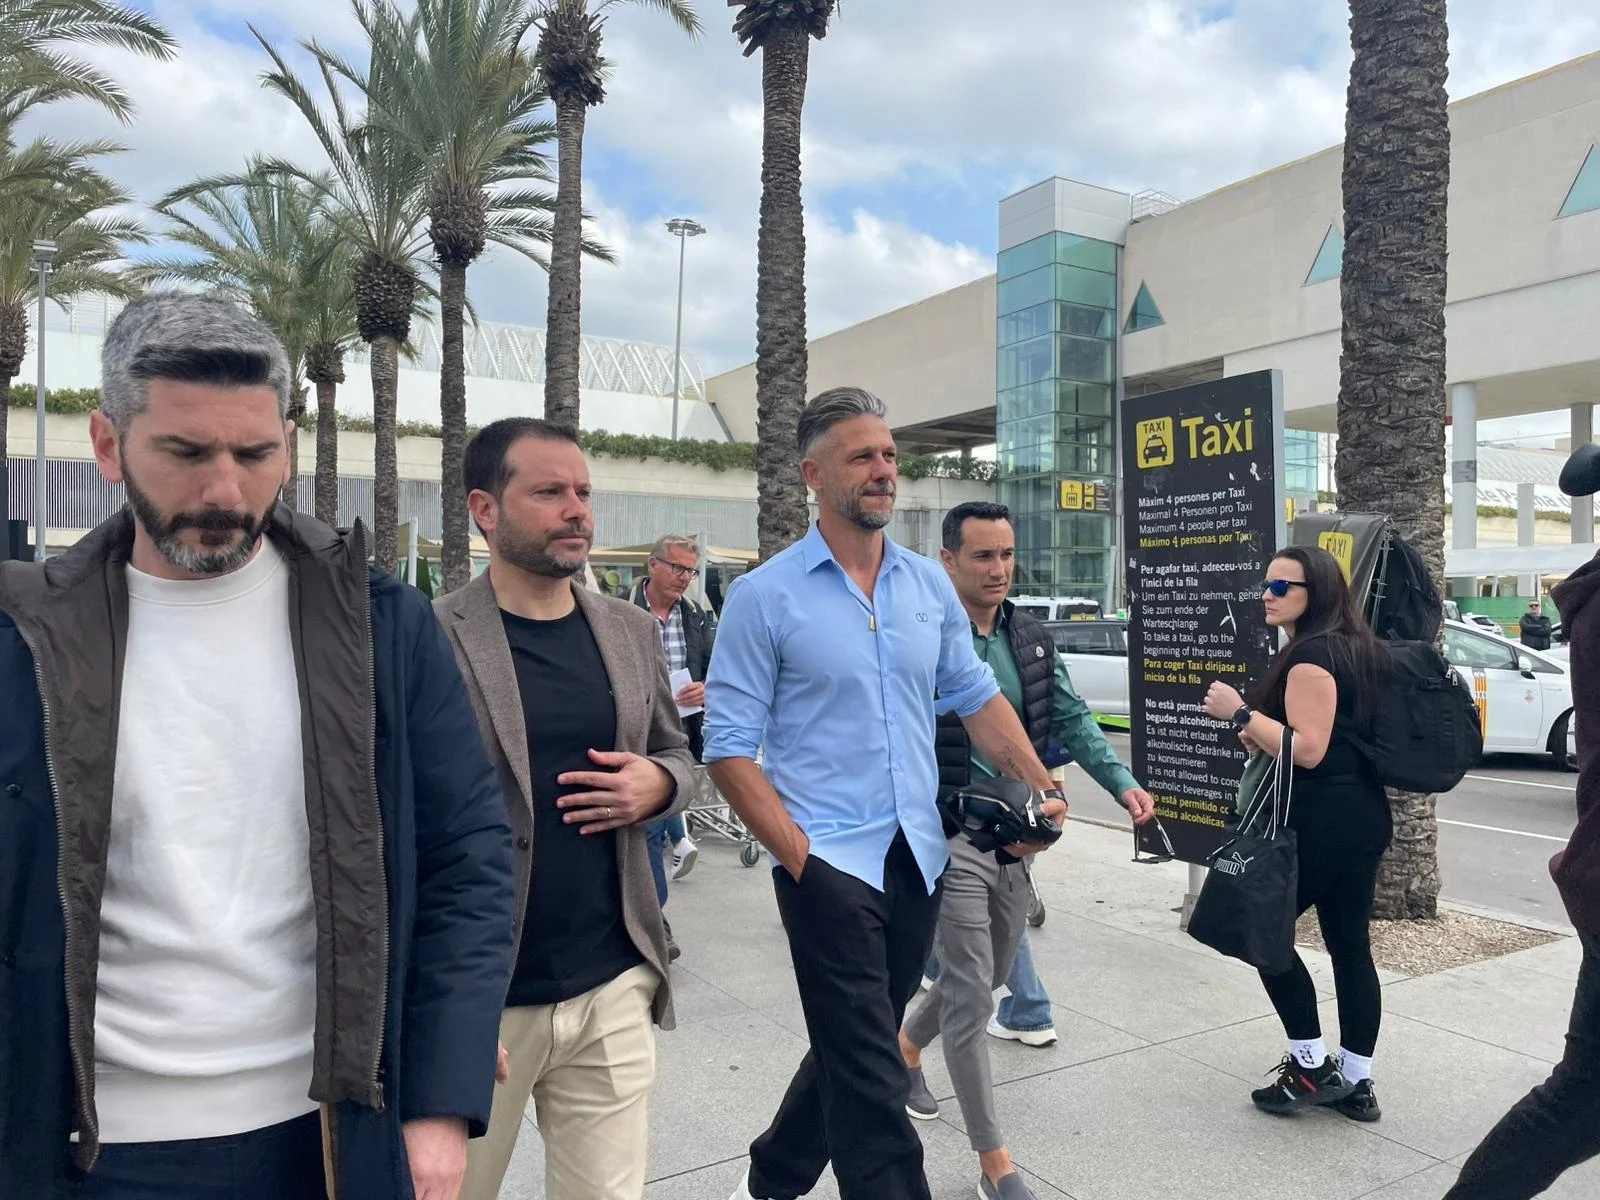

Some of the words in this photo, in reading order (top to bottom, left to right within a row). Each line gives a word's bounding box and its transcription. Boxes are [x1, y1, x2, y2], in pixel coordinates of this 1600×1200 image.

[1143, 421, 1165, 434] TAXI
[1181, 407, 1253, 459] Taxi
[1138, 496, 1164, 507] Màxim
[1166, 495, 1172, 504] 4
[1174, 492, 1209, 506] persones
[1212, 491, 1226, 502] per
[1228, 487, 1245, 498] Taxi
[1139, 508, 1171, 521] Maximal
[1173, 508, 1179, 517] 4
[1181, 505, 1217, 517] Personen
[1220, 504, 1234, 516] pro
[1236, 500, 1252, 512] Taxi
[1139, 523, 1176, 534] Maximum
[1179, 521, 1185, 531] 4
[1187, 519, 1214, 532] people
[1216, 519, 1230, 531] per
[1232, 516, 1247, 527] taxi
[1140, 537, 1170, 548] Máximo
[1172, 536, 1178, 545] 4
[1180, 534, 1216, 547] personas
[1218, 533, 1233, 544] por
[1235, 531, 1252, 542] Taxi
[1325, 538, 1347, 558] TAXI
[1140, 564, 1153, 574] Per
[1155, 563, 1180, 575] agafar
[1182, 562, 1200, 573] taxi,
[1202, 560, 1252, 572] adreceu-vos
[1141, 578, 1162, 588] l'inici
[1164, 578, 1174, 587] de
[1176, 577, 1184, 587] la
[1186, 577, 1198, 587] fila
[1141, 592, 1155, 601] Um
[1157, 591, 1169, 601] ein
[1171, 591, 1187, 601] Taxi
[1189, 592, 1198, 600] zu
[1200, 590, 1236, 602] nehmen,
[1142, 605, 1155, 615] Sie
[1156, 606, 1172, 615] zum
[1174, 605, 1194, 615] ende
[1195, 605, 1209, 615] der
[1142, 618, 1198, 630] Warteschlange
[1143, 631, 1152, 641] To
[1154, 632, 1170, 642] take
[1171, 634, 1177, 642] a
[1179, 632, 1196, 643] taxi,
[1198, 634, 1208, 644] go
[1210, 634, 1219, 643] to
[1220, 633, 1234, 644] the
[1143, 645, 1180, 657] beginning
[1182, 646, 1190, 656] of
[1192, 646, 1205, 657] the
[1207, 649, 1232, 659] queue
[1144, 658, 1161, 668] Para
[1163, 660, 1185, 671] coger
[1187, 660, 1203, 670] Taxi
[1237, 662, 1246, 673] al
[1144, 672, 1165, 682] inicio
[1167, 672, 1177, 683] de
[1179, 673, 1187, 683] la
[1188, 673, 1201, 684] fila
[1145, 698, 1156, 708] No
[1145, 712, 1178, 724] begudes
[1180, 713, 1230, 730] alcohòliques
[1146, 725, 1156, 735] Es
[1157, 726, 1167, 736] ist
[1168, 728, 1188, 739] nicht
[1190, 730, 1218, 742] erlaubt
[1146, 740, 1193, 753] alkoholische
[1195, 744, 1231, 758] Getränke
[1233, 750, 1245, 760] im
[1146, 753, 1156, 762] zu
[1158, 753, 1207, 769] konsumieren
[1147, 765, 1153, 775] It
[1155, 766, 1161, 776] is
[1163, 768, 1176, 778] not
[1178, 770, 1208, 783] allowed
[1210, 774, 1219, 785] to
[1220, 778, 1241, 789] cons
[1147, 778, 1181, 791] alcoholic
[1183, 783, 1223, 800] beverages
[1224, 790, 1233, 800] in
[1179, 797, 1218, 812] permitido
[1153, 807, 1178, 819] ebidas
[1180, 812, 1225, 828] alcohólicas
